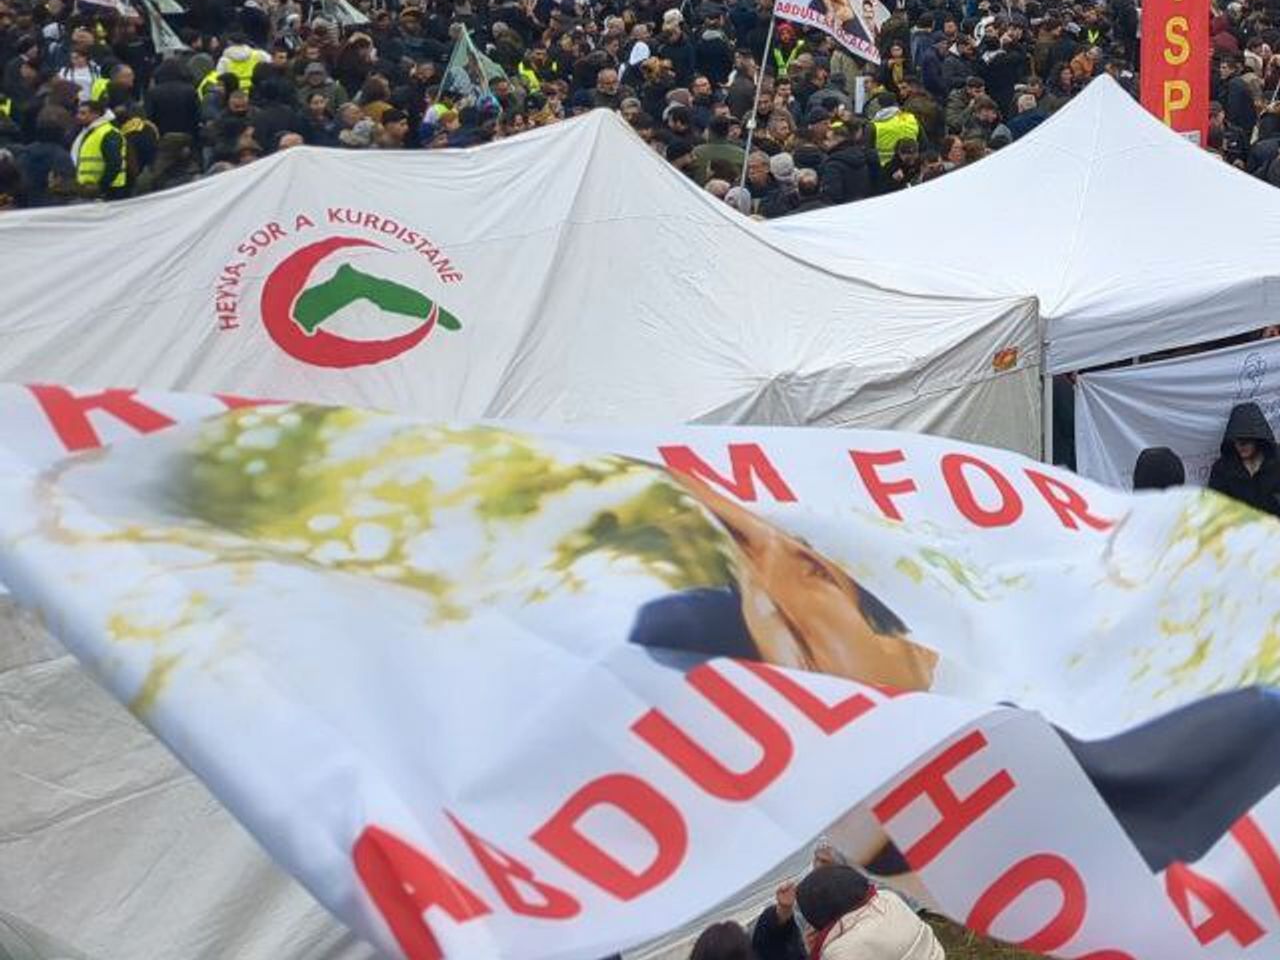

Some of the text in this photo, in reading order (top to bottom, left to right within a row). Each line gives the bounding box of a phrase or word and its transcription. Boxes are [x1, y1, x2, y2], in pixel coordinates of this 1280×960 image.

[216, 208, 463, 331] HEYVA SOR A KURDISTANÊ
[849, 449, 1121, 533] FOR
